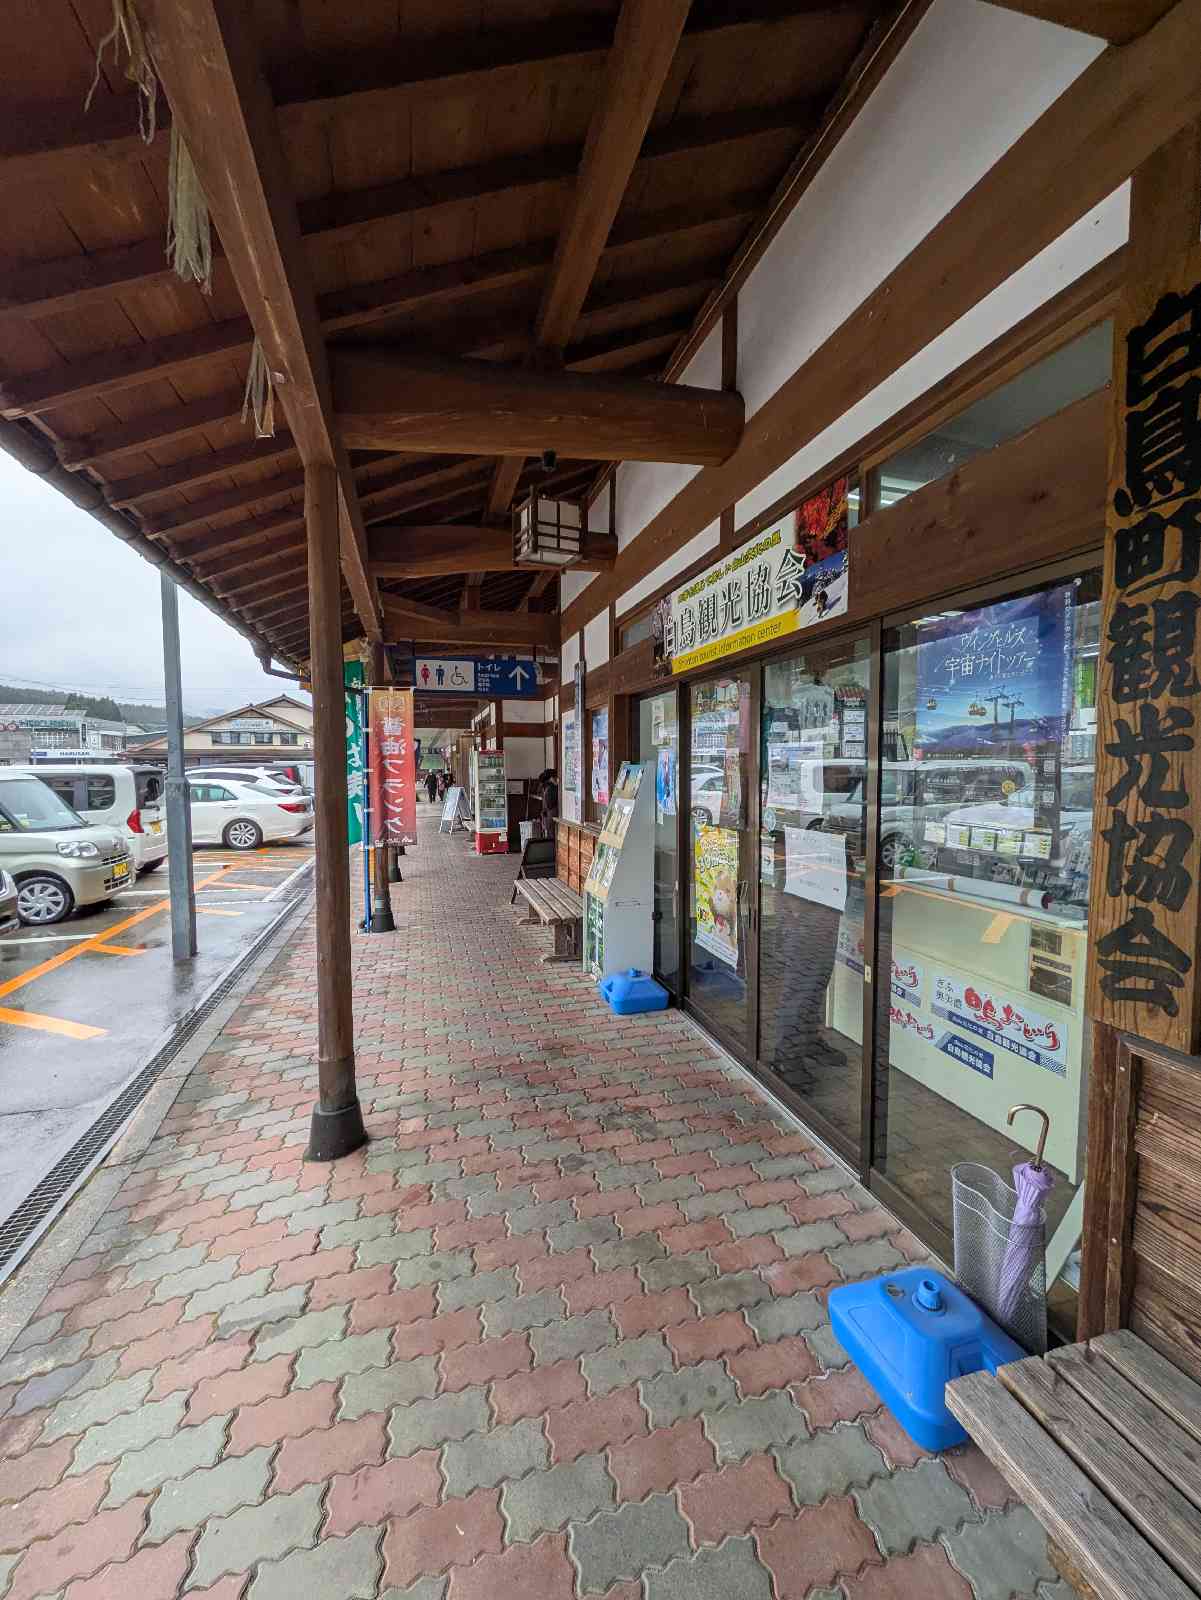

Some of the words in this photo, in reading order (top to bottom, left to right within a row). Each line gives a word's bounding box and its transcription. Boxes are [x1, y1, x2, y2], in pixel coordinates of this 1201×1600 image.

[663, 548, 807, 658] 白鳥観光協会
[477, 661, 502, 672] トイレ
[944, 649, 1036, 680] 宇宙ナイトツアー
[1096, 284, 1200, 1018] 白鳥町観光協会
